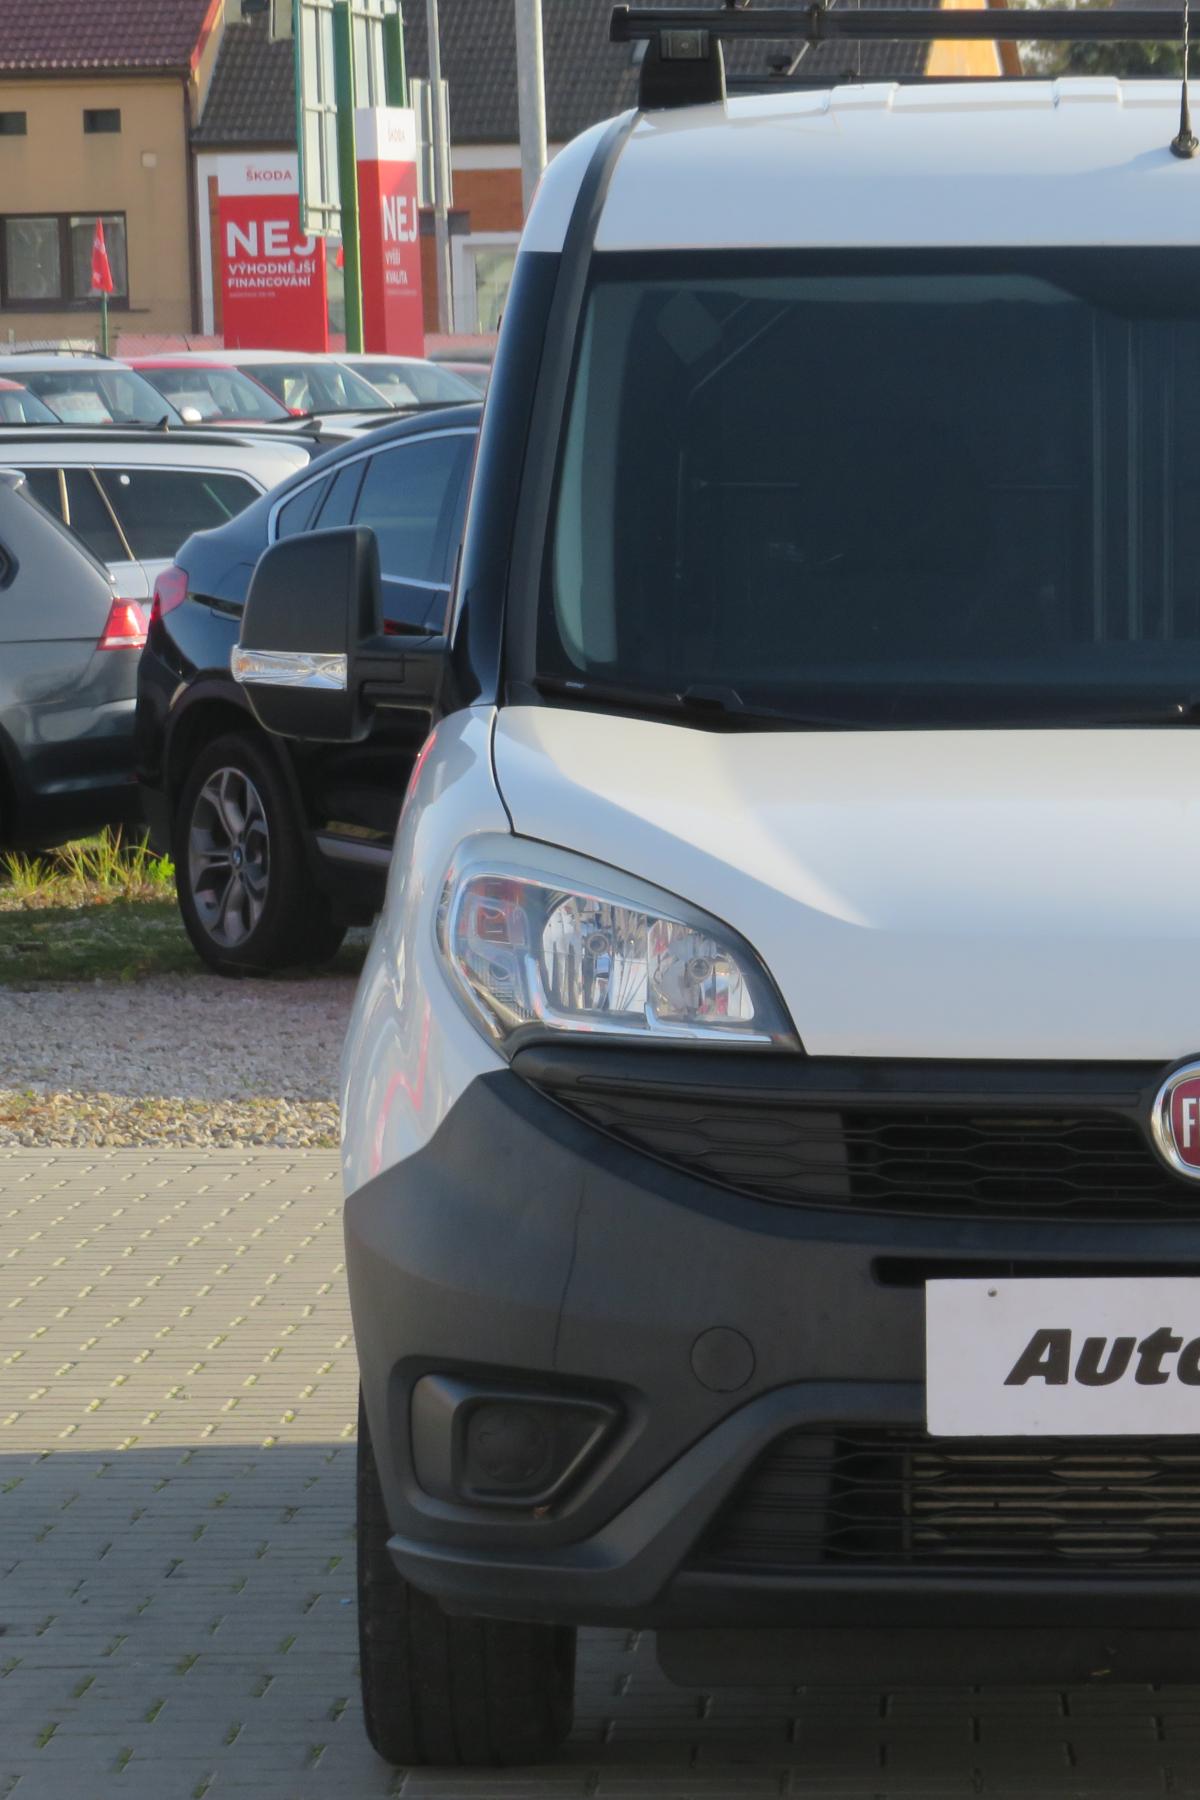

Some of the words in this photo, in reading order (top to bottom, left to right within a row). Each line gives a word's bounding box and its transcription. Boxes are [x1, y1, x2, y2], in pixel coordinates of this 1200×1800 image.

[245, 164, 292, 181] ŠKODA
[382, 194, 418, 242] NEJ
[226, 220, 316, 257] NEJ
[228, 259, 316, 275] VÝHODNĚJŠÍ
[227, 275, 311, 288] FINANCOVÁNÍ
